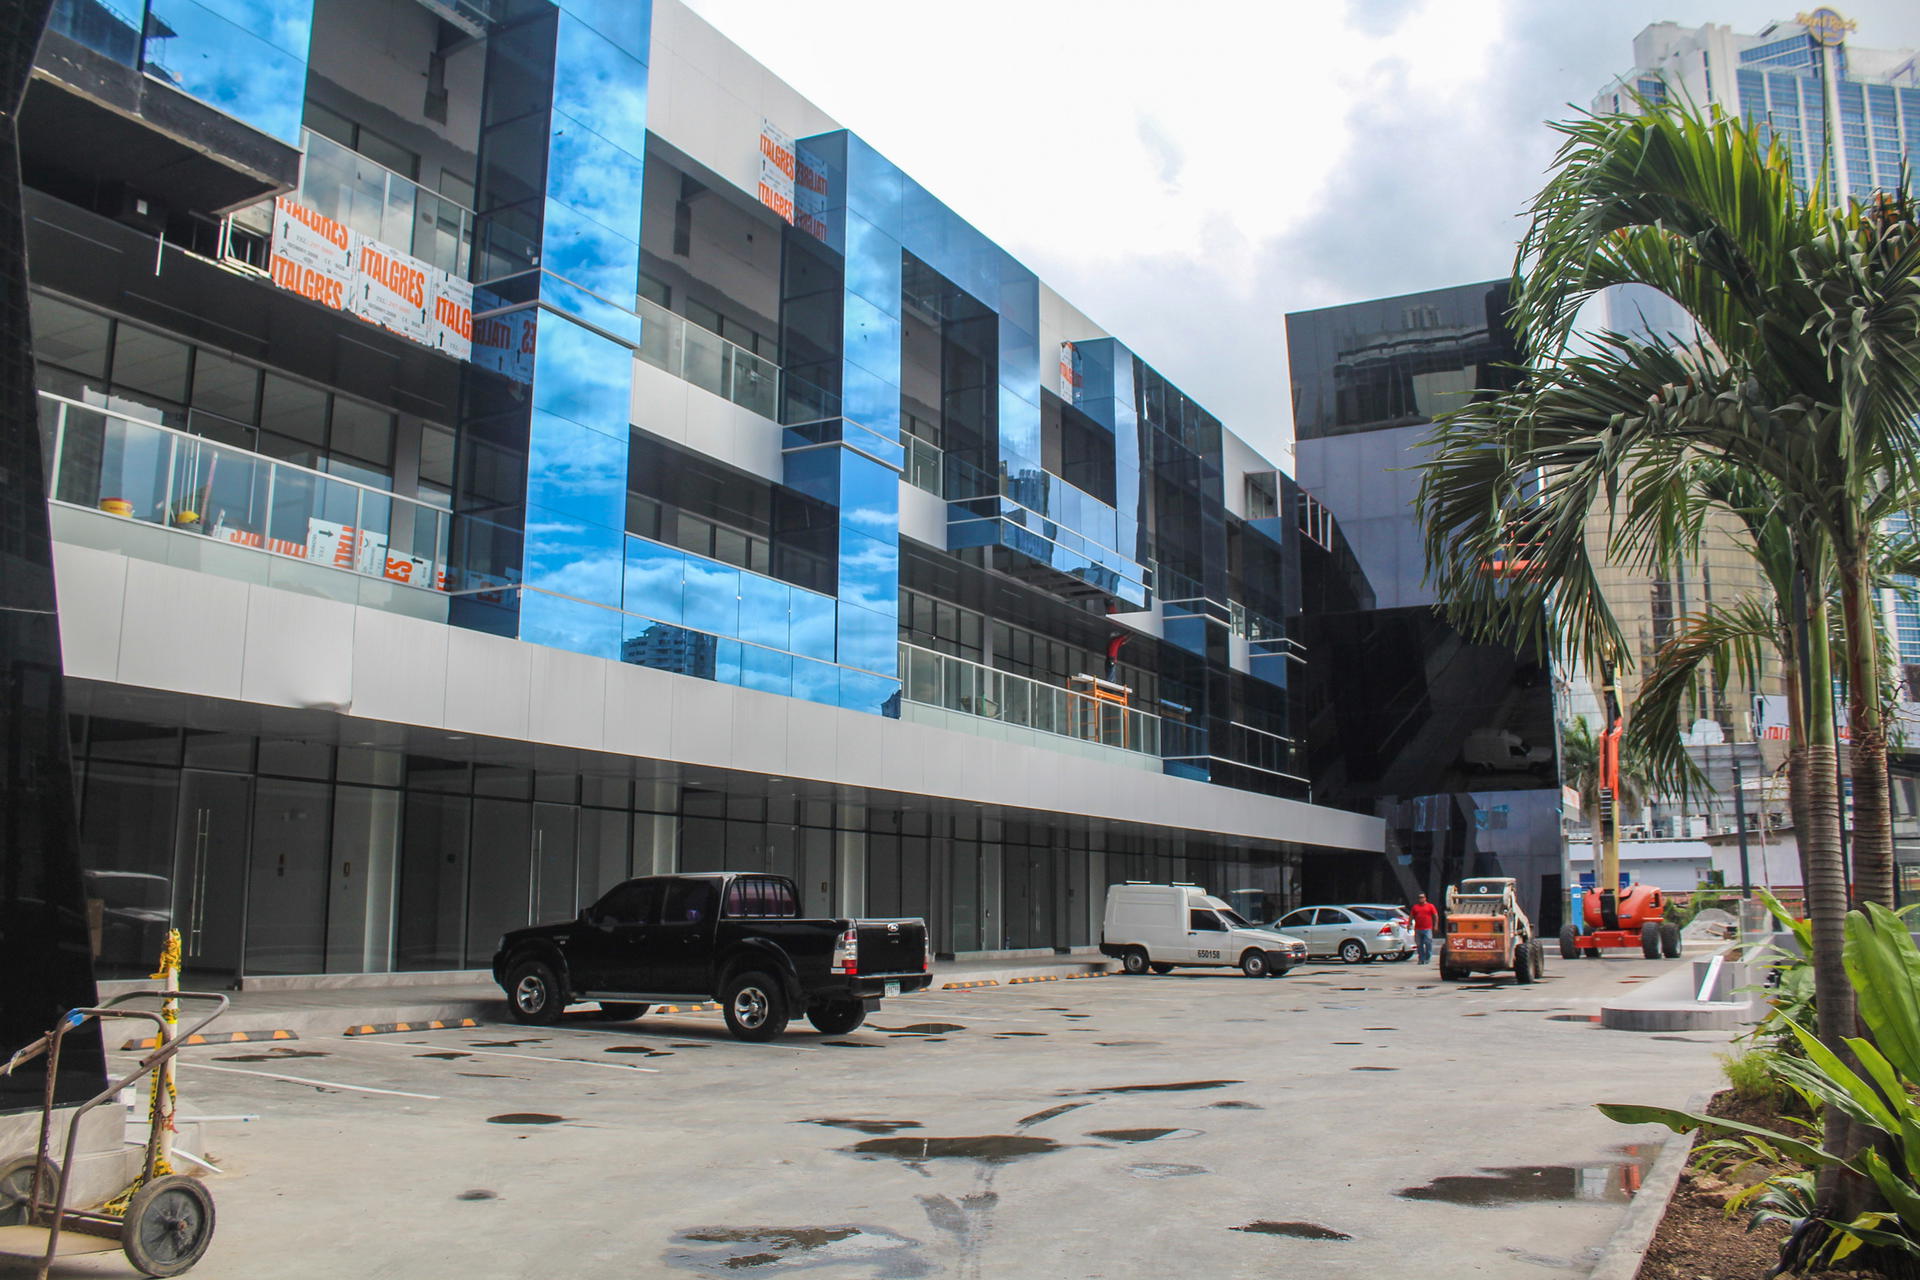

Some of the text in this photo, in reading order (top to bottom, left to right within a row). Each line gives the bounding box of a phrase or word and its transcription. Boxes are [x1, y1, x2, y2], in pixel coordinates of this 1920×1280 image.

[759, 133, 795, 182] ITALGRES
[758, 182, 794, 227] ITALGRES
[271, 253, 343, 311] ITALGRES
[361, 246, 425, 309] ITALGRES
